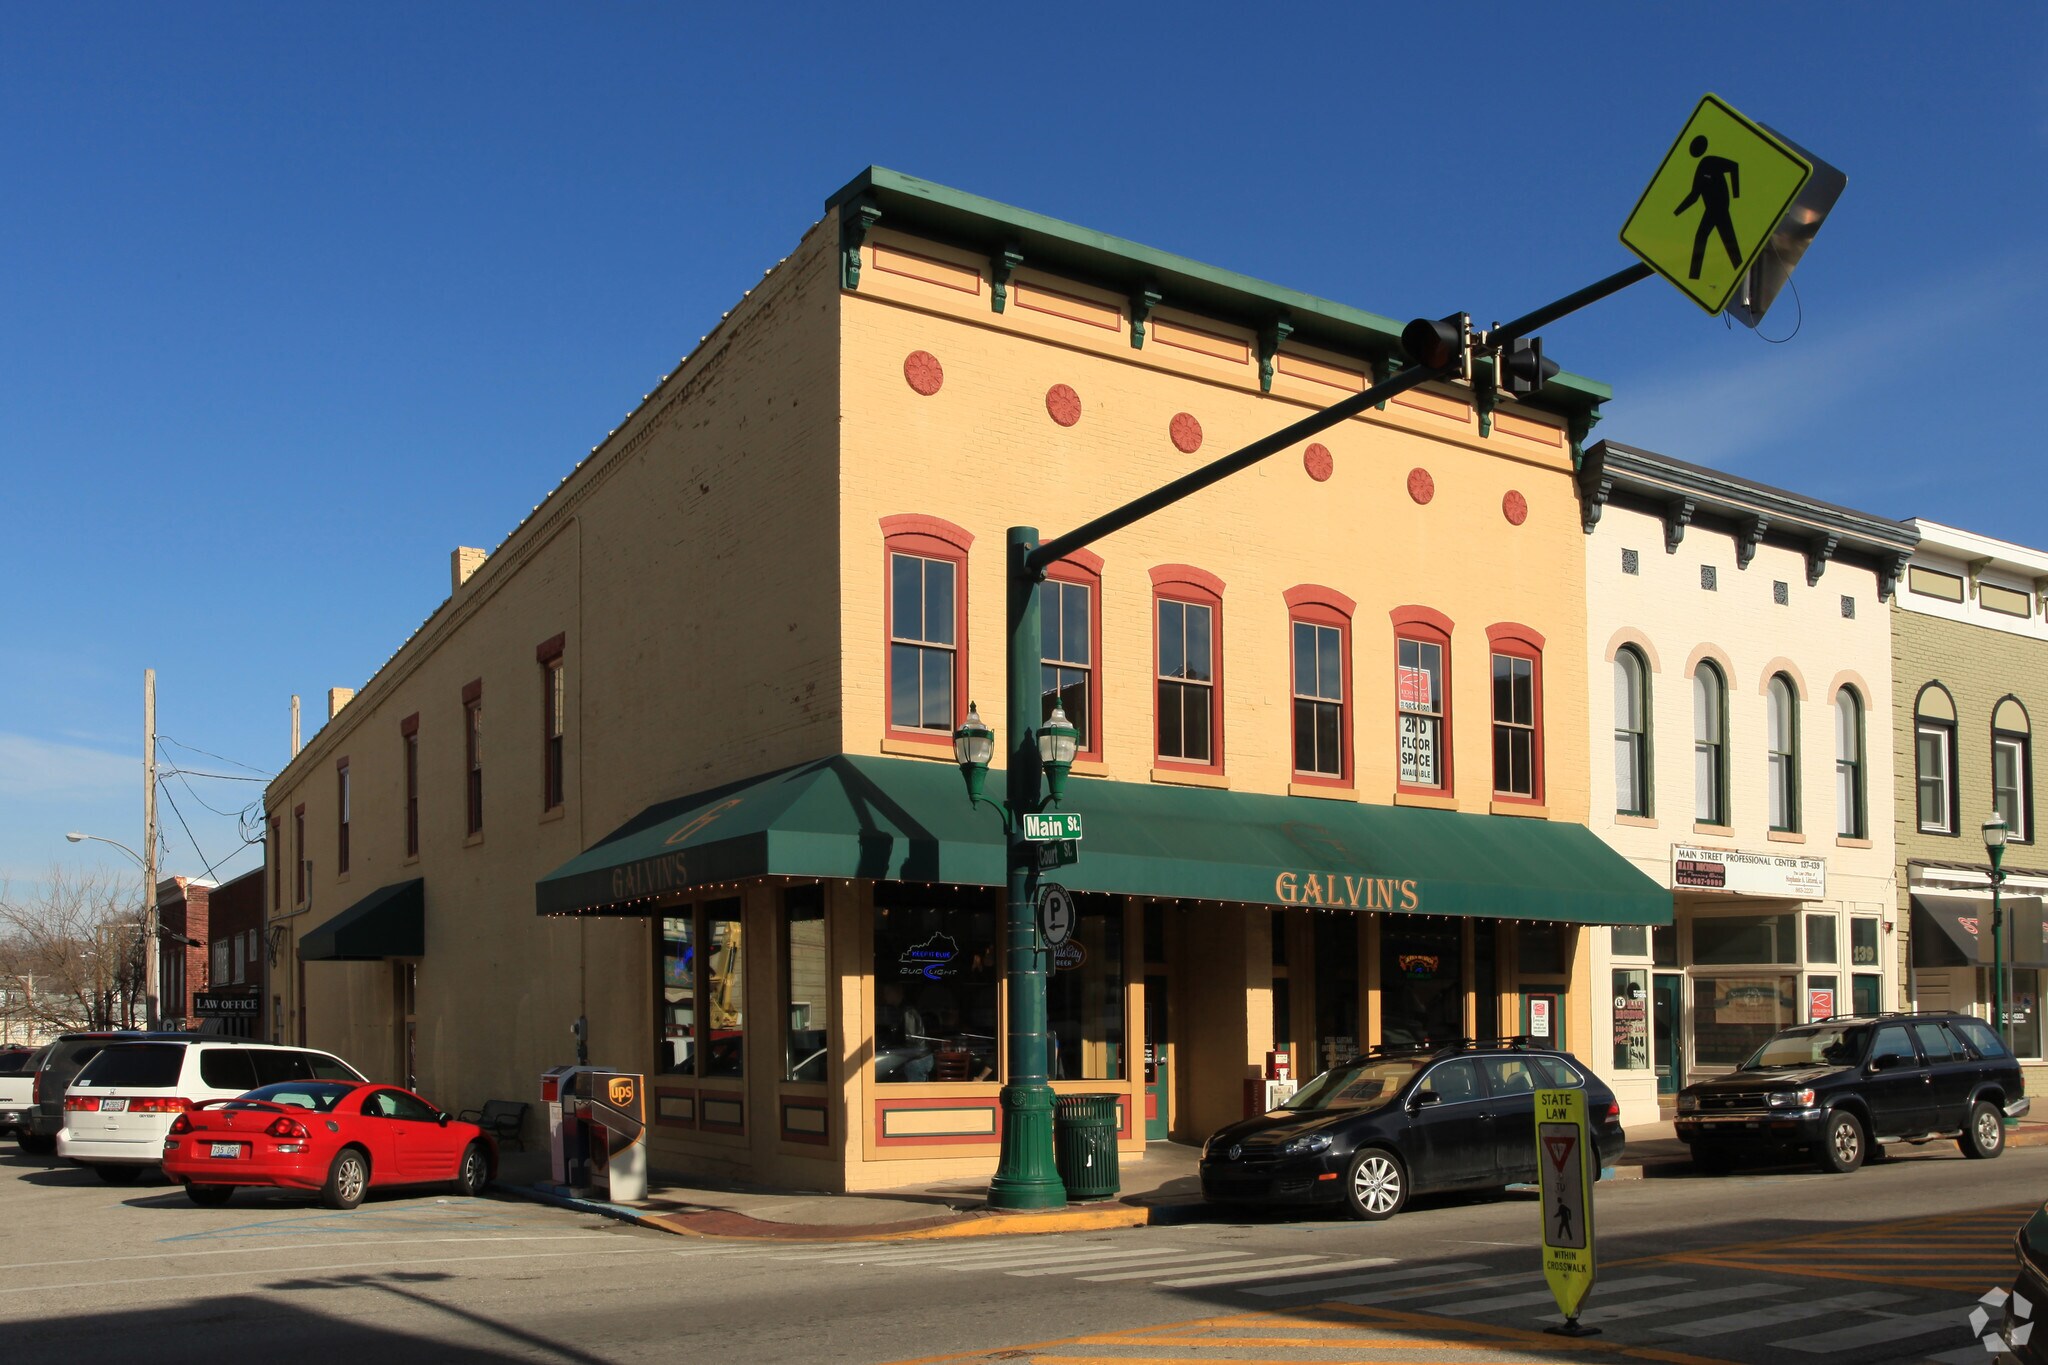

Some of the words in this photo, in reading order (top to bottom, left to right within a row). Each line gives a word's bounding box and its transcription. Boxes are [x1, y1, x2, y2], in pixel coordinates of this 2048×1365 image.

[1402, 737, 1430, 751] FLOOR
[1402, 752, 1430, 767] SPACE
[1026, 816, 1063, 836] Main
[1067, 816, 1080, 831] St.
[1040, 845, 1058, 866] Court
[1063, 842, 1073, 857] St.
[1678, 850, 1697, 859] MAIN
[1700, 852, 1722, 861] STREET
[1726, 854, 1771, 866] PROFESSIONAL
[1774, 858, 1797, 867] CENTER
[1677, 861, 1694, 871] HAIR
[613, 852, 687, 898] GALVIN'S
[1276, 872, 1419, 911] GALVIN'S
[1050, 897, 1061, 922] P
[1854, 946, 1874, 961] 139
[900, 967, 922, 975] BUD
[196, 998, 218, 1009] LAW
[221, 1000, 258, 1009] OFFICE
[611, 1086, 633, 1103] ups
[1542, 1094, 1573, 1106] STATE
[1546, 1108, 1567, 1119] LAW
[212, 1146, 223, 1154] 735
[1554, 1251, 1576, 1260] WITHIN
[1547, 1261, 1587, 1273] CROSSWALK
